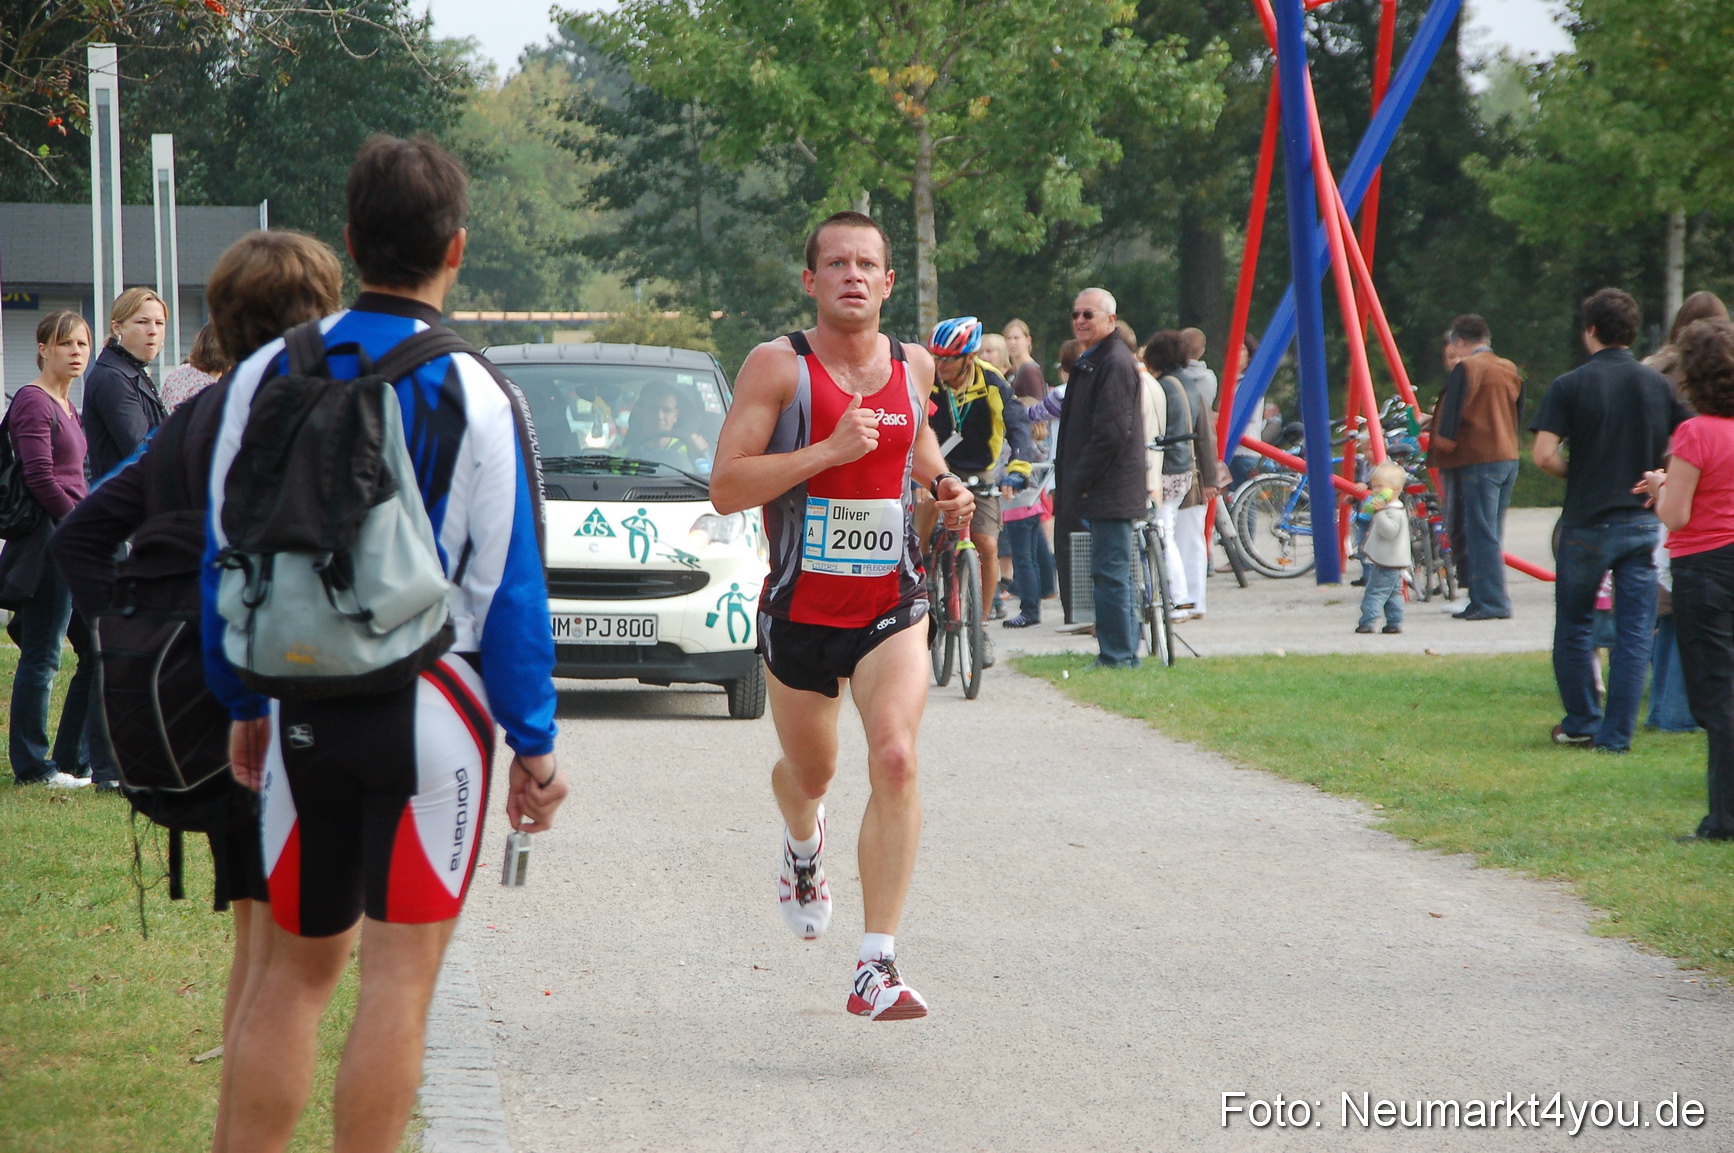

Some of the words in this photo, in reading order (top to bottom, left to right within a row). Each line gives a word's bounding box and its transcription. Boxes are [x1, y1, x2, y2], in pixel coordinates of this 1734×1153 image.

[882, 413, 908, 426] asics
[832, 505, 871, 521] Oliver
[807, 526, 815, 538] A
[831, 529, 894, 552] 2000
[585, 618, 612, 637] PJ
[616, 618, 654, 638] 800
